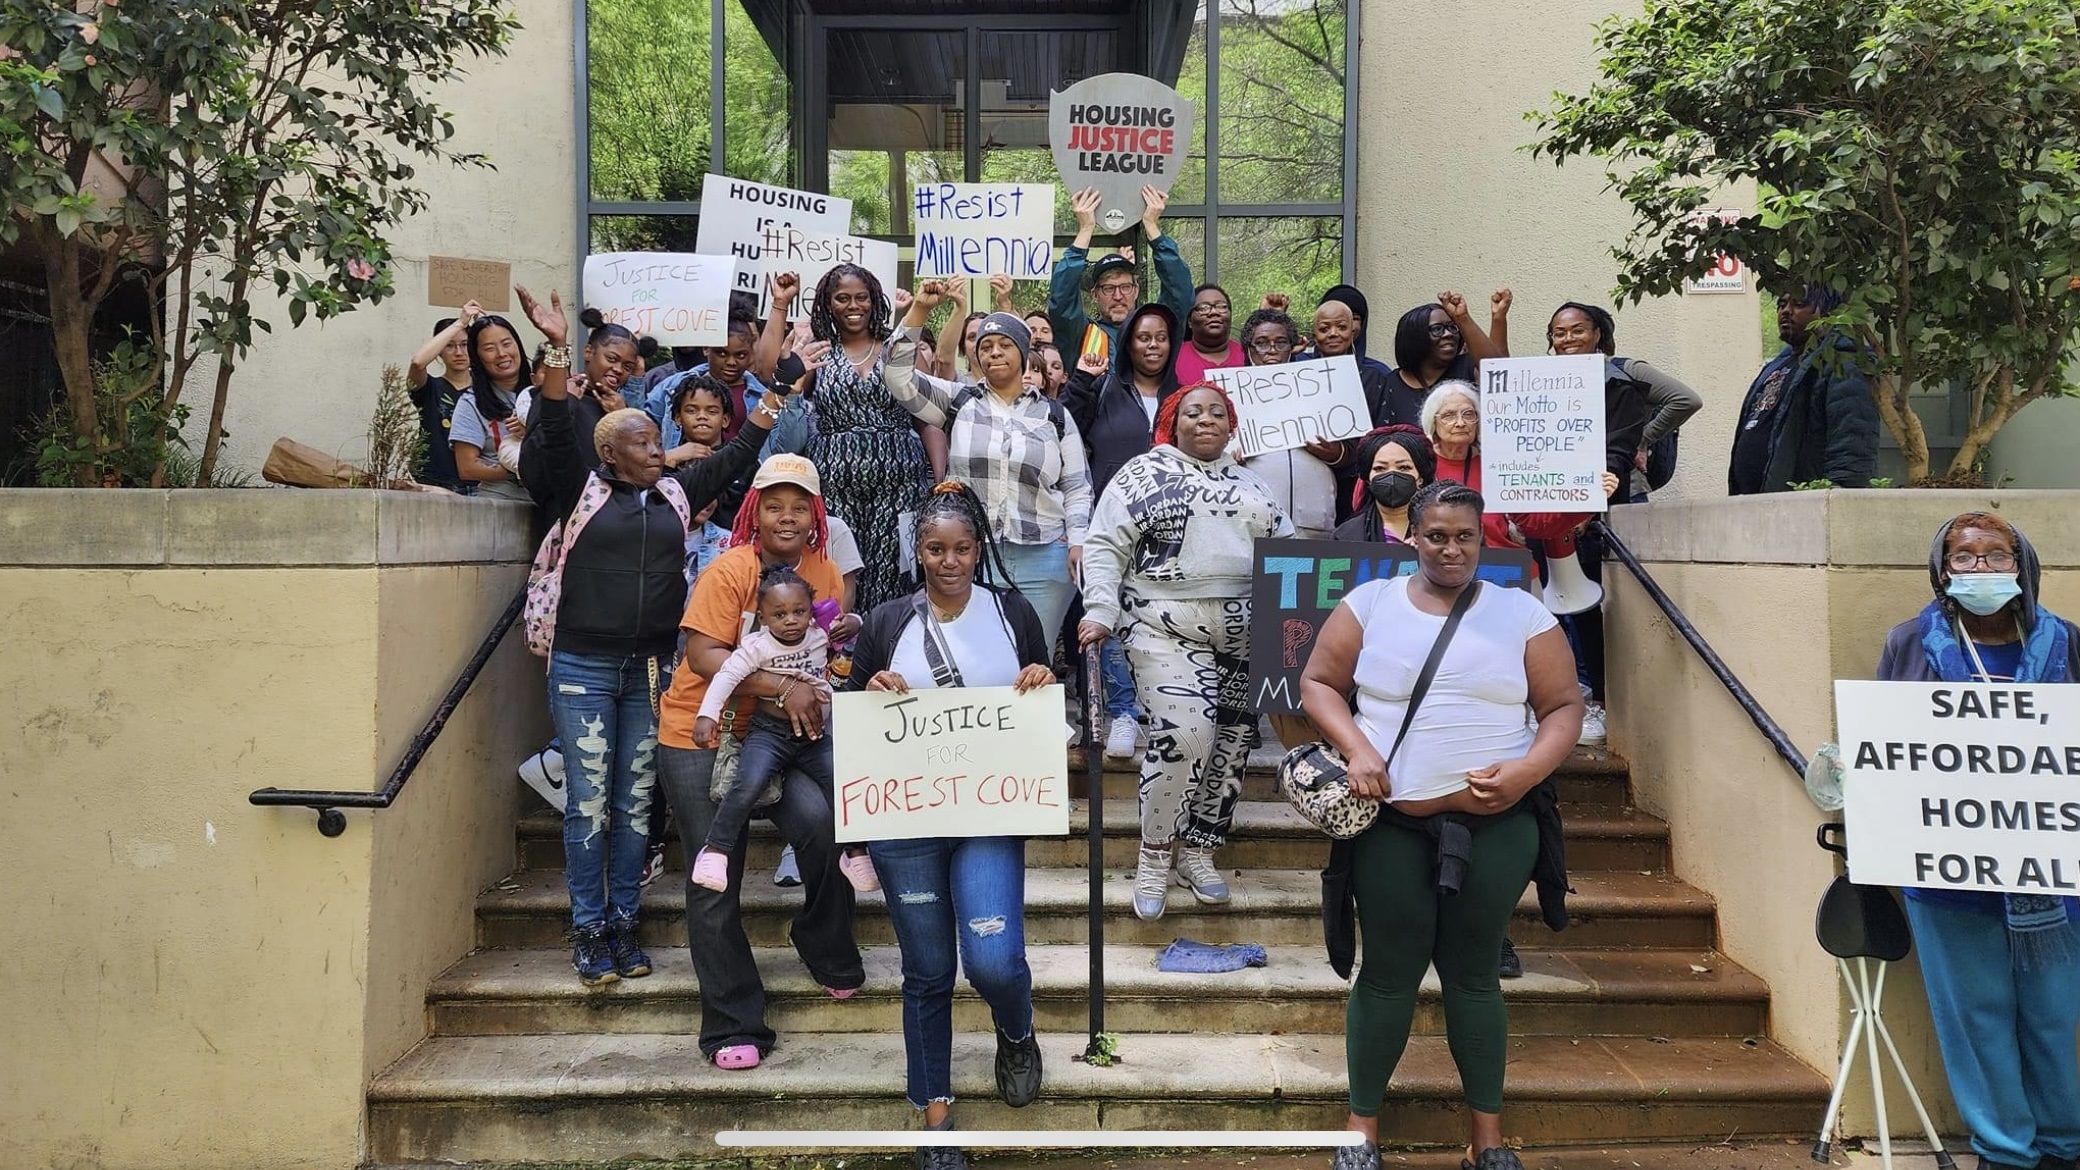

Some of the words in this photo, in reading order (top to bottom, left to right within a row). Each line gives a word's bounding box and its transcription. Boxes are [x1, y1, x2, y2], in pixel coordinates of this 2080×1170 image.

[1069, 104, 1175, 128] HOUSING
[1067, 125, 1174, 154] JUSTICE
[1078, 152, 1164, 174] LEAGUE
[730, 183, 827, 214] HOUSING
[915, 184, 1024, 219] #Resist
[761, 228, 865, 265] #Resist
[916, 231, 1050, 275] Millennia
[439, 271, 499, 287] HOUSING
[603, 259, 703, 288] JUSTICE
[1692, 281, 1742, 289] TRESPASSING
[631, 288, 659, 303] FOR
[662, 307, 720, 332] COVE
[1212, 359, 1336, 406] #Resist
[1486, 369, 1586, 394] Millennia
[1487, 399, 1512, 416] Our
[1516, 394, 1558, 415] Motto
[1567, 396, 1582, 412] is
[1237, 404, 1369, 455] illennia
[1557, 418, 1593, 433] OVER
[1499, 473, 1566, 486] TENANTS
[1573, 472, 1595, 486] and
[1146, 496, 1189, 517] JORDAN
[1500, 489, 1590, 501] CONTRACTORS
[1149, 507, 1187, 527] JORDAN
[884, 697, 1015, 743] JUSTICE
[1931, 690, 2049, 725] SAFE,
[927, 743, 973, 765] FOR
[1854, 741, 2080, 775] AFFORDAB
[1201, 743, 1231, 818] JORDAN
[842, 775, 967, 827] FOREST
[977, 775, 1059, 807] COVE
[1921, 797, 2080, 832] HOMES
[1915, 852, 2004, 886] FOR
[2017, 857, 2080, 888] AL
